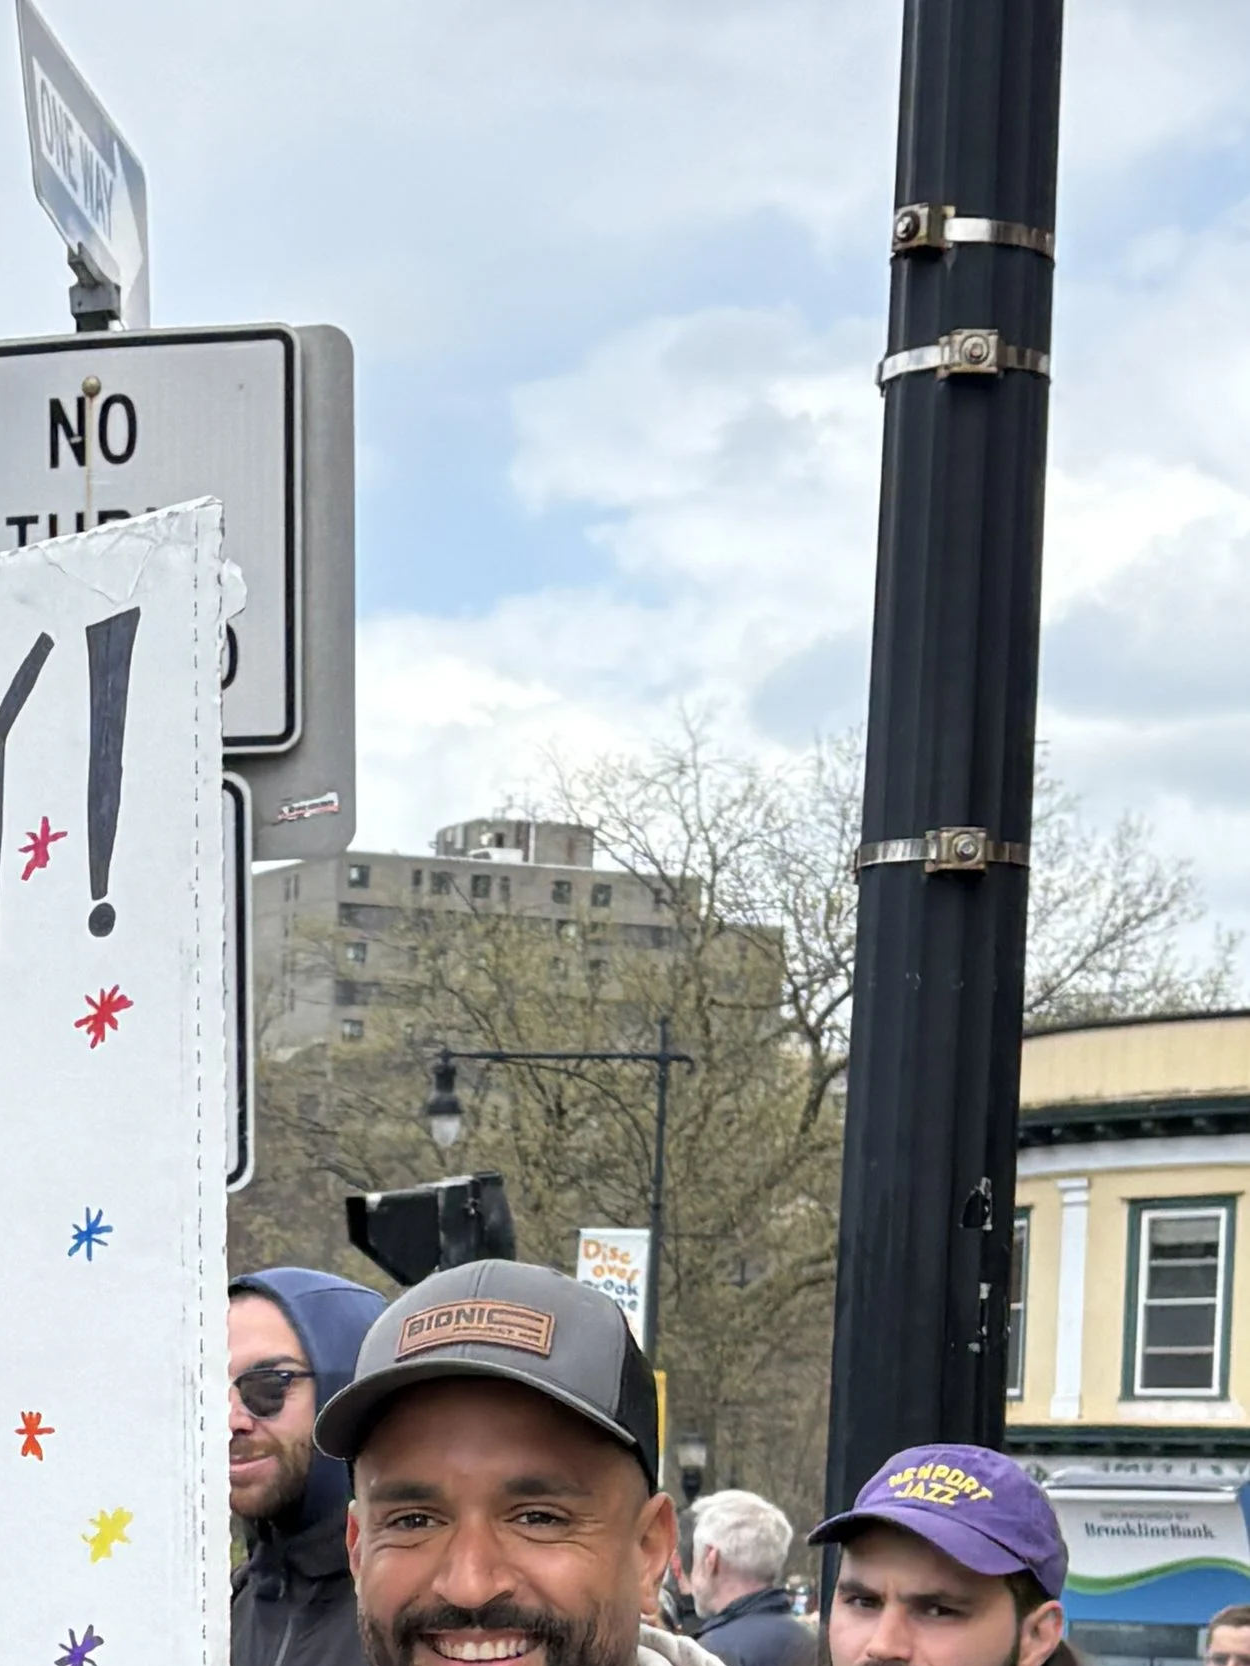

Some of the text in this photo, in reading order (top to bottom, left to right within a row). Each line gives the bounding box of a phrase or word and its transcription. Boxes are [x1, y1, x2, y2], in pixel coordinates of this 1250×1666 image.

[40, 78, 114, 241] ONE WAY
[49, 393, 137, 469] NO
[407, 1308, 544, 1338] BIONIC
[889, 1463, 993, 1500] NEWPORT
[894, 1481, 960, 1505] JAZZ
[1084, 1521, 1216, 1539] BrooklineBank
